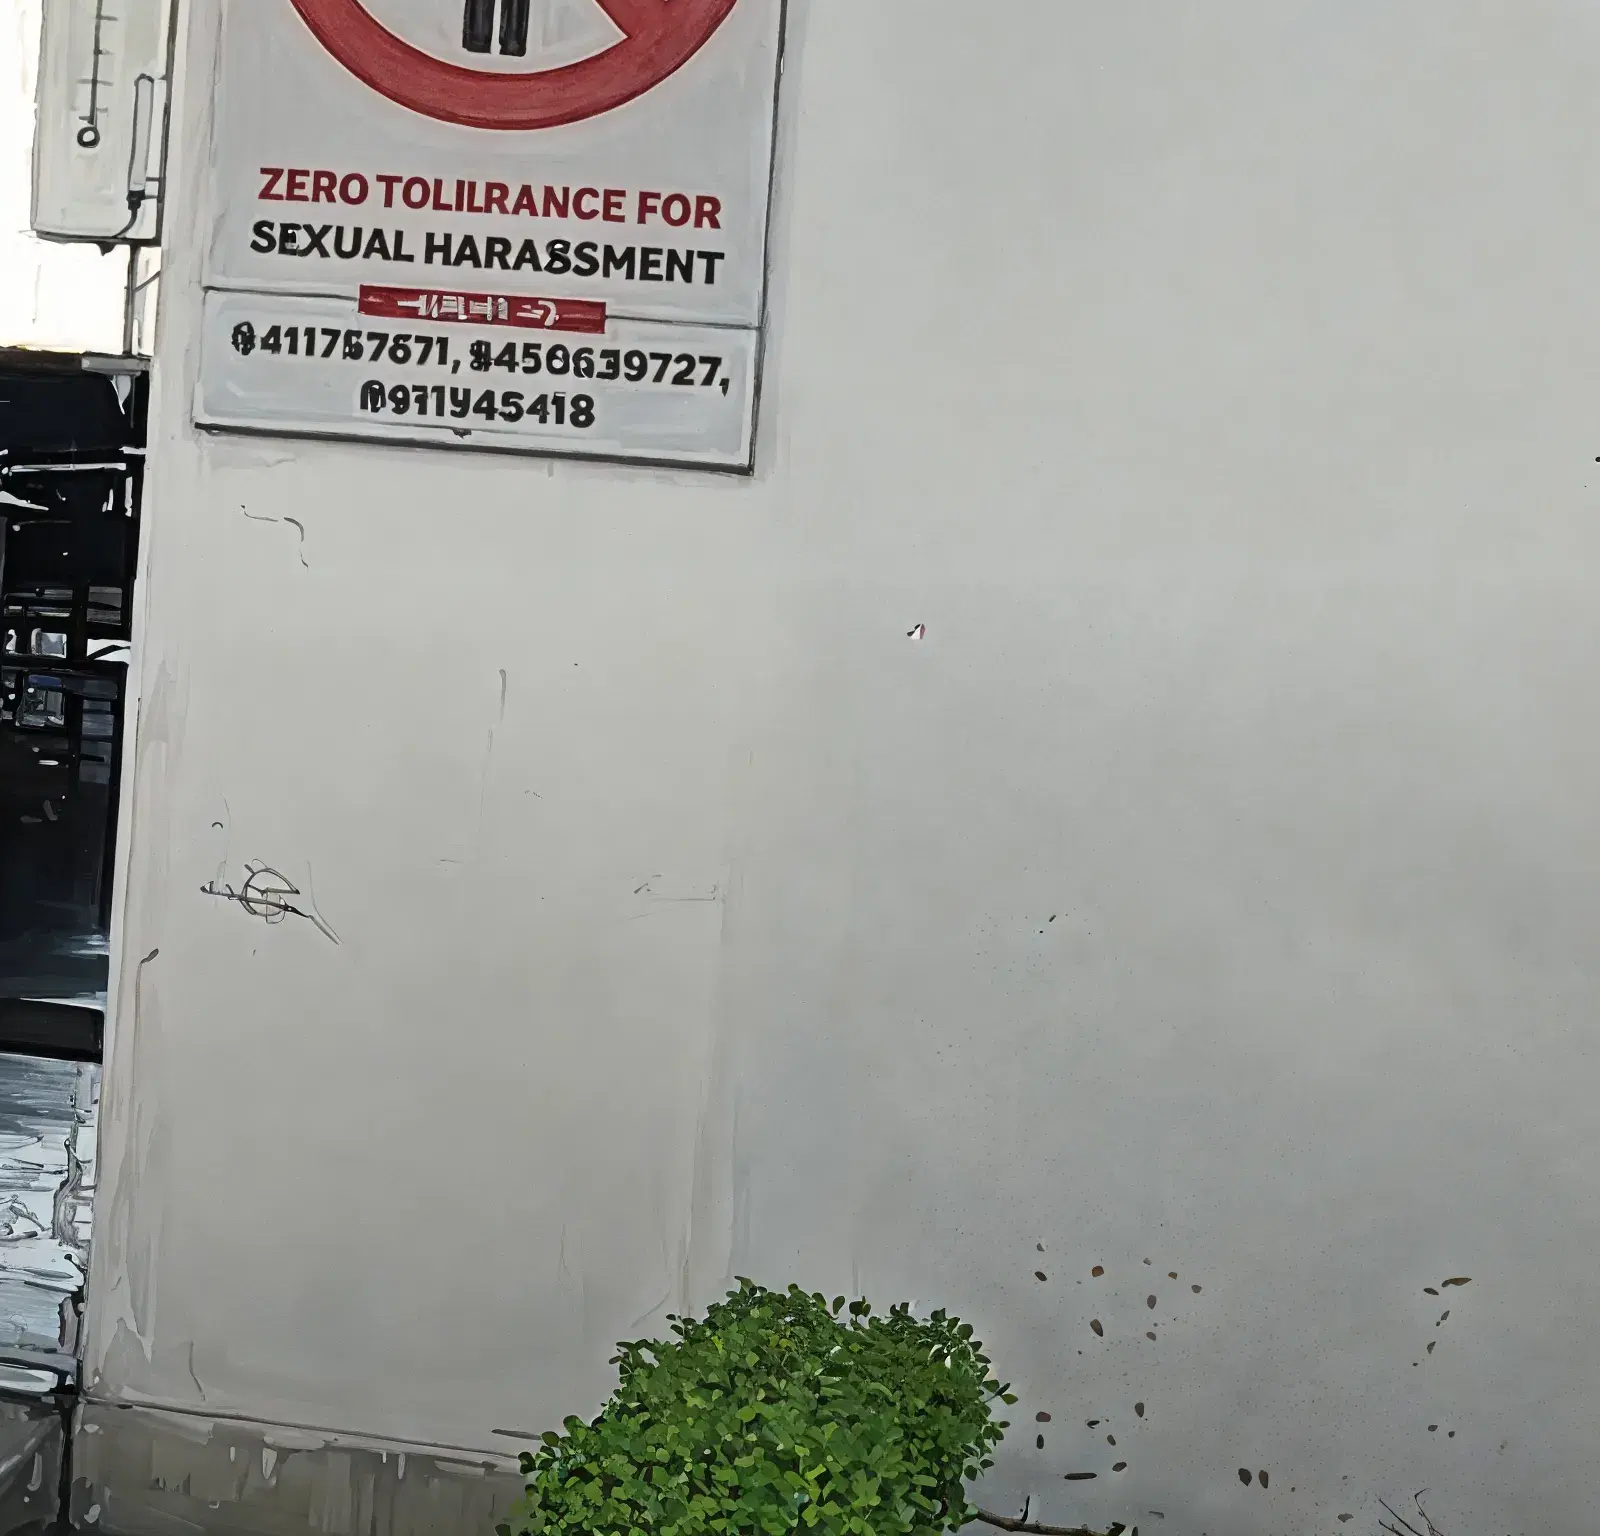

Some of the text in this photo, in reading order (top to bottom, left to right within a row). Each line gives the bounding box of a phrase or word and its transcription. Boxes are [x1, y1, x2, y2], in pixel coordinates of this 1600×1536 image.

[257, 167, 369, 206] ZERO
[637, 190, 722, 230] FOR
[250, 219, 726, 285] SEXUAL HARASSMENT
